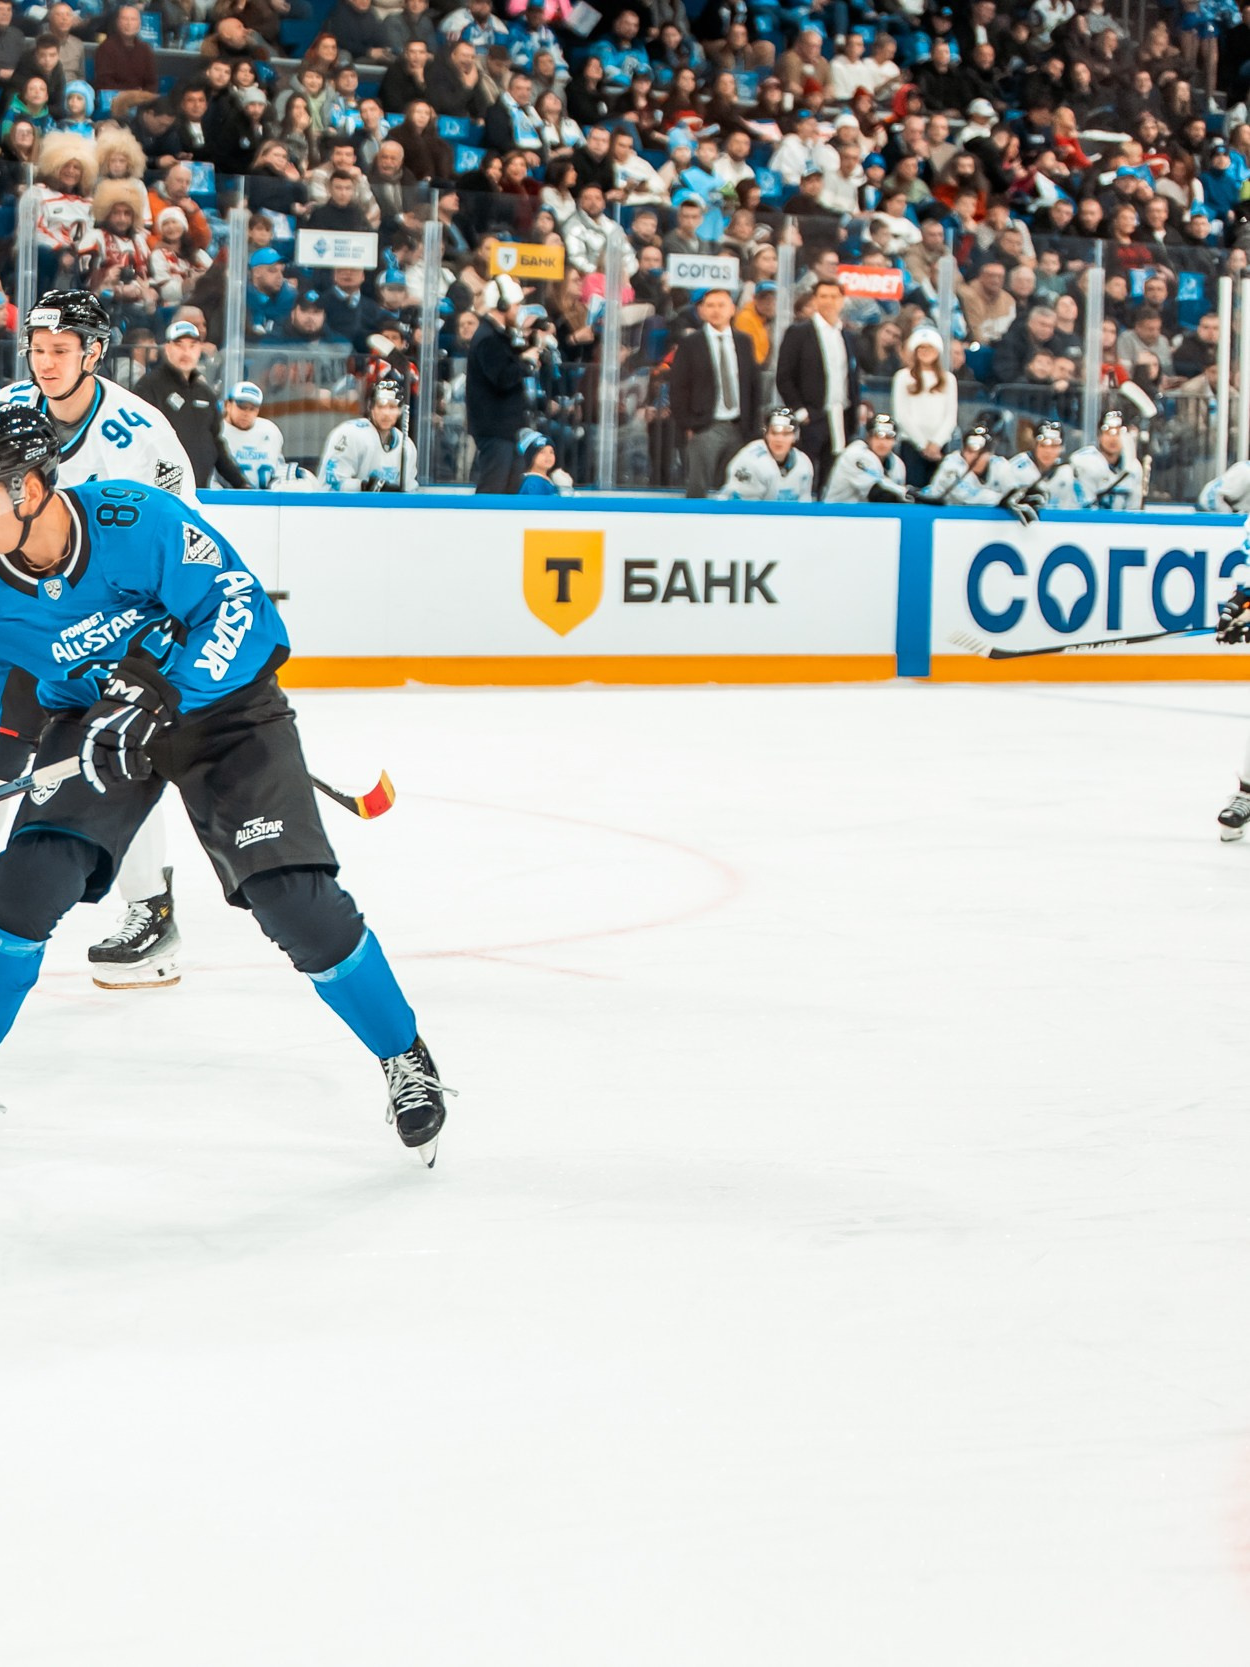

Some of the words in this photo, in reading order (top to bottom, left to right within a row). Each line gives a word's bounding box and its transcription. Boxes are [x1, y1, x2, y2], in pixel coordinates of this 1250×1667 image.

[521, 255, 555, 267] БАНК
[102, 408, 153, 450] 94
[25, 446, 48, 461] CCM
[96, 487, 150, 529] 89
[622, 559, 780, 604] БАНК
[59, 611, 105, 643] FONBET
